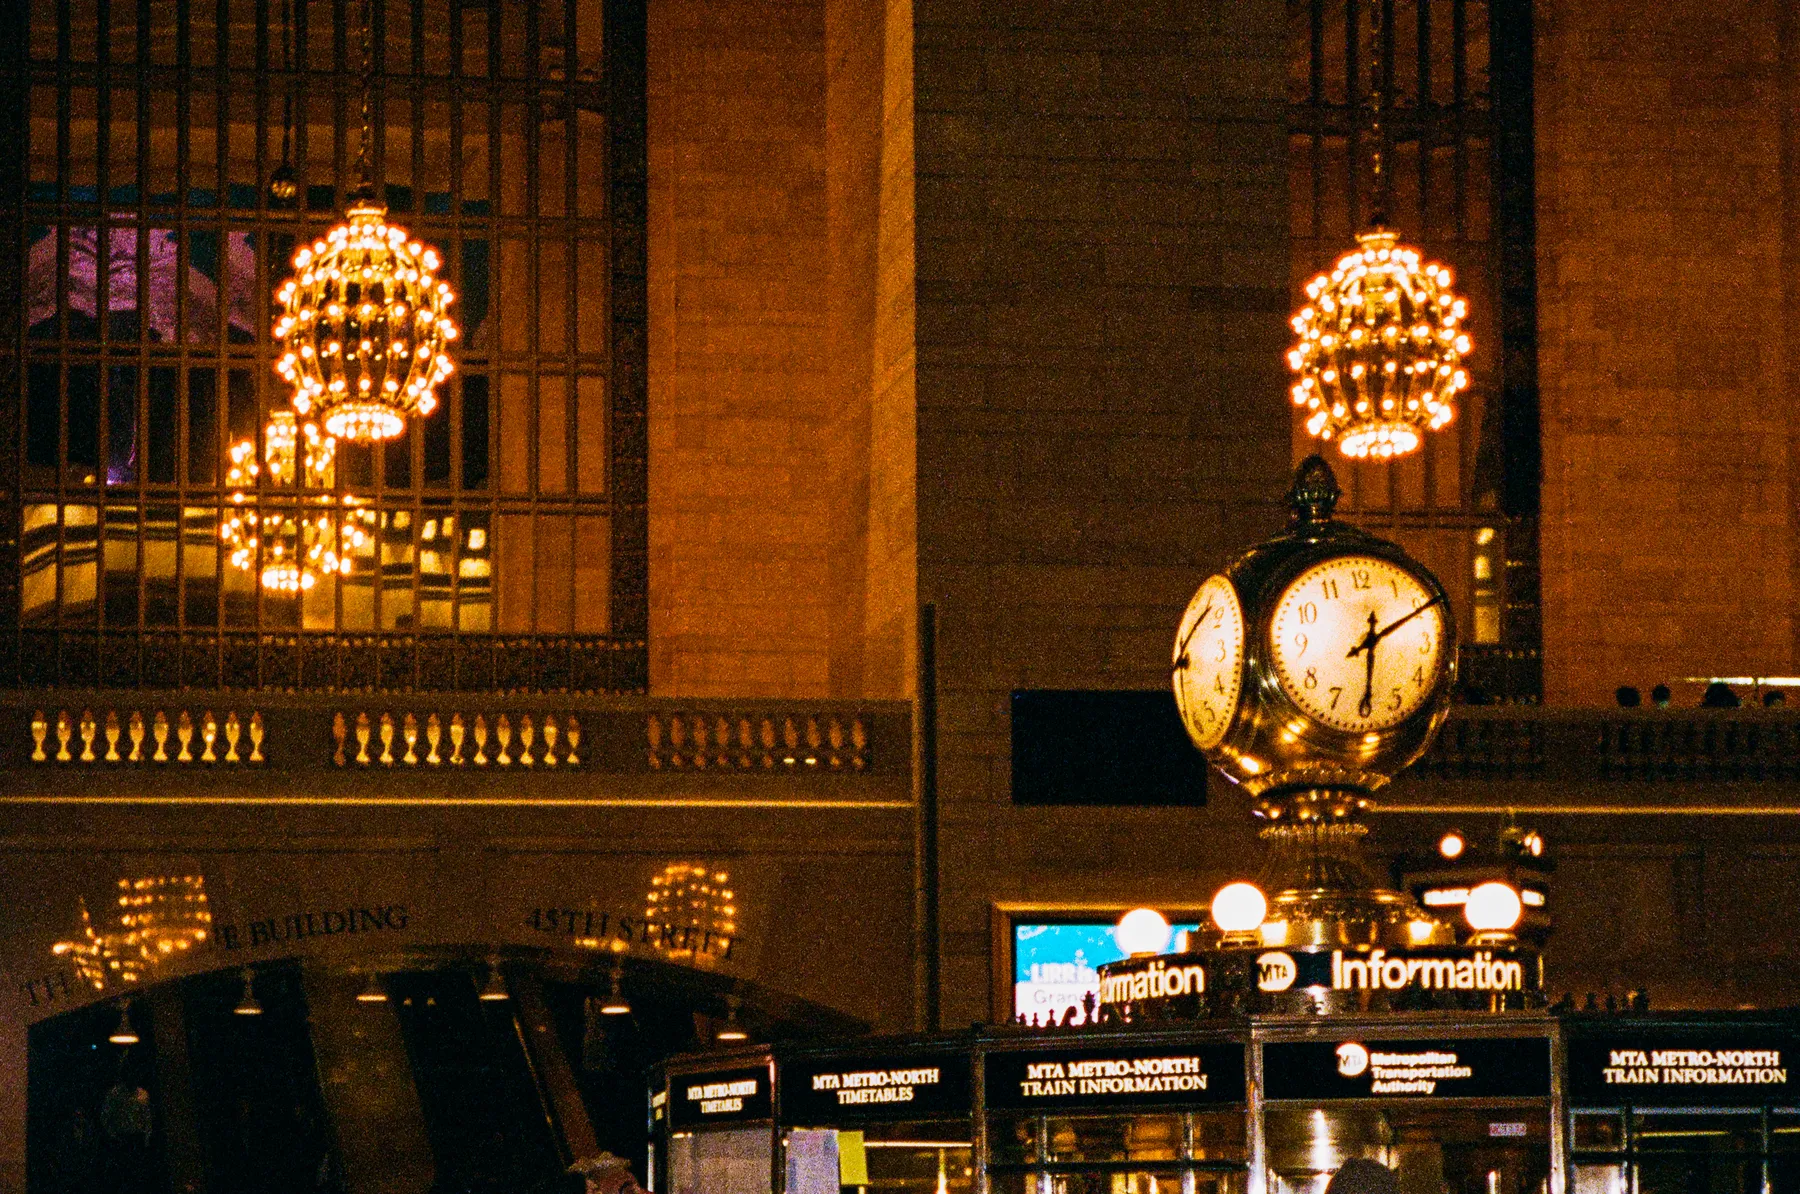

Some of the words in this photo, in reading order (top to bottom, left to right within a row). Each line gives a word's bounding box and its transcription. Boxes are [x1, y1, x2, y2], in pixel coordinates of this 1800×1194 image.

[1321, 579, 1339, 600] 11
[1351, 569, 1371, 589] 12
[1391, 579, 1399, 598] 1
[1298, 601, 1318, 625] 10
[1214, 638, 1227, 663] 3
[1294, 632, 1309, 659] 9
[1418, 631, 1431, 655] 3
[1213, 674, 1225, 696] 4
[1303, 666, 1318, 690] 8
[1412, 665, 1424, 688] 4
[1328, 686, 1343, 711] 7
[1386, 687, 1402, 711] 5
[1203, 700, 1216, 723] 5
[250, 905, 409, 946] BUILDING
[525, 907, 609, 938] 45TH
[619, 915, 743, 960] STREET
[1331, 949, 1522, 990] Information
[1027, 1063, 1065, 1079] MTA
[1067, 1057, 1199, 1078] METRO-NORTH
[1370, 1051, 1457, 1068] Metropolitan
[1610, 1050, 1648, 1067] MTA
[1651, 1050, 1780, 1067] METRO-NORTH
[812, 1074, 840, 1090] MTA
[841, 1067, 939, 1088] METRO-NORTH
[1371, 1065, 1472, 1080] Transportation
[1602, 1067, 1659, 1084] TRAIN
[1663, 1067, 1787, 1084] INFORMATION
[836, 1086, 913, 1104] TIMETABLES
[1019, 1079, 1076, 1096] TRAIN
[1079, 1074, 1207, 1095] INFORMATION
[1371, 1079, 1436, 1094] Authority
